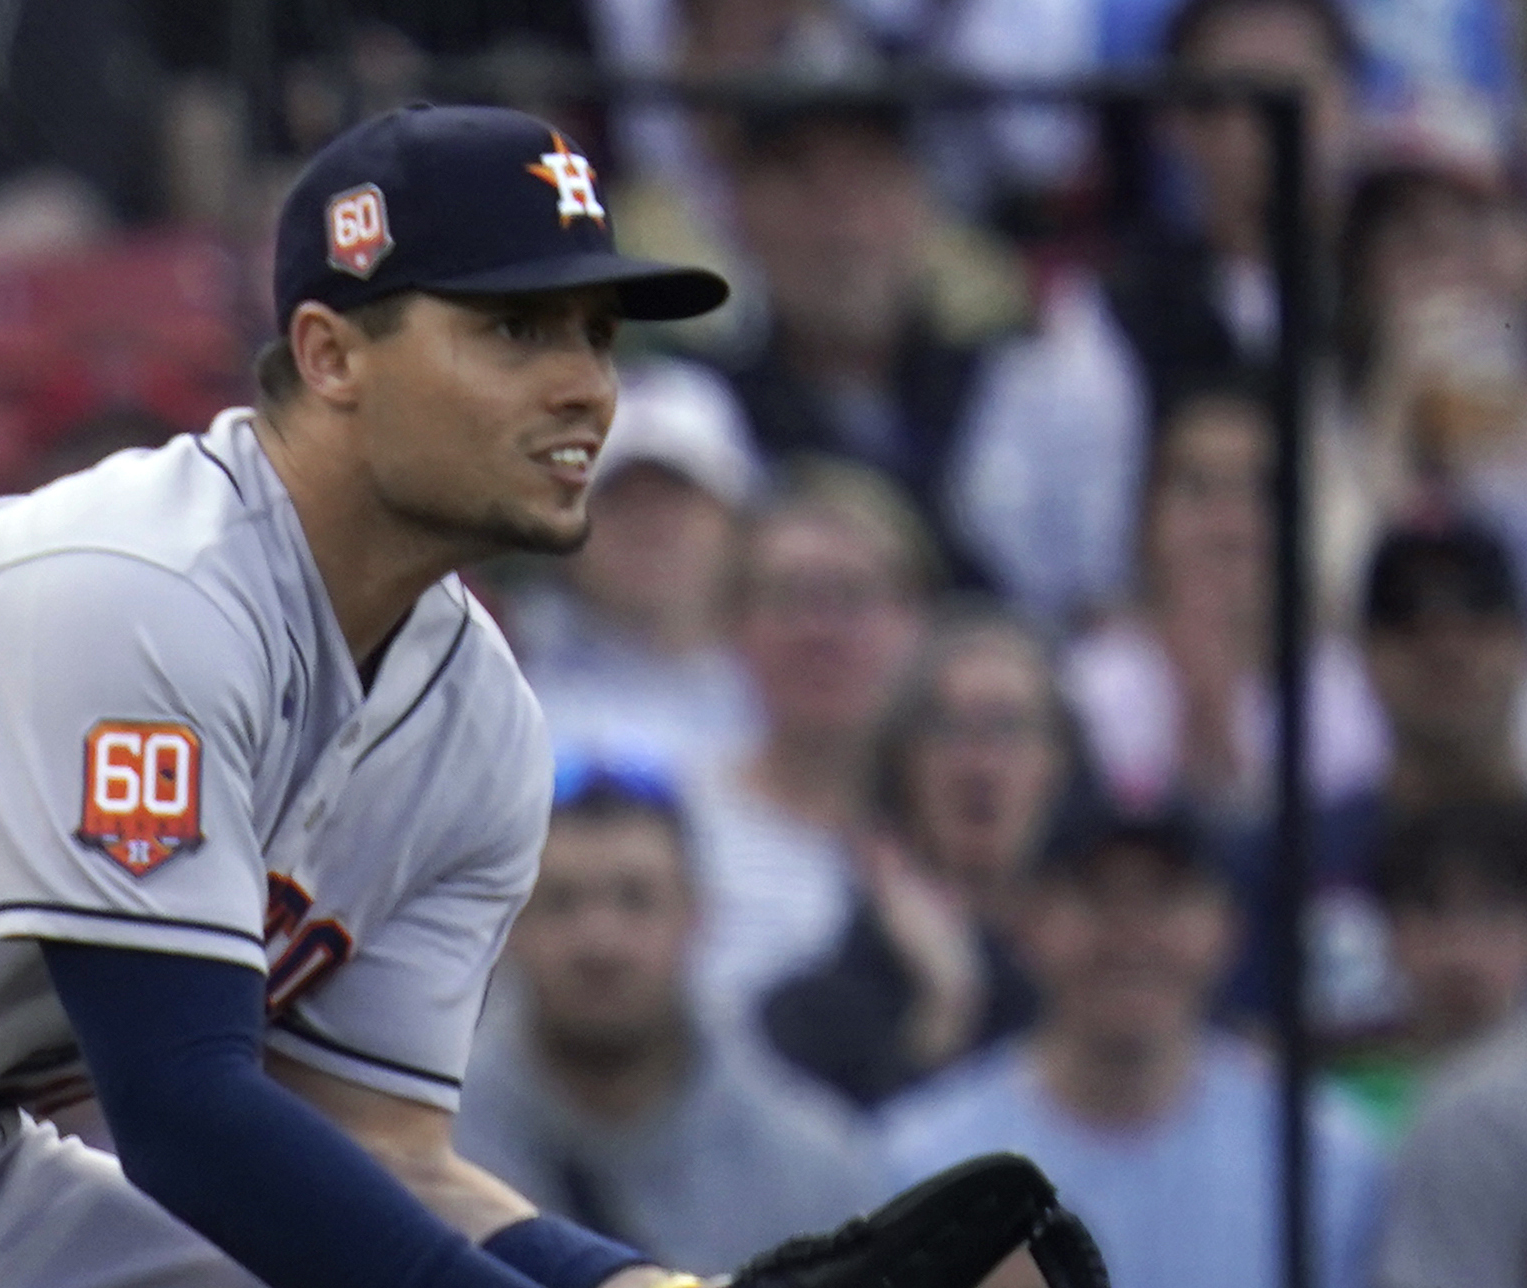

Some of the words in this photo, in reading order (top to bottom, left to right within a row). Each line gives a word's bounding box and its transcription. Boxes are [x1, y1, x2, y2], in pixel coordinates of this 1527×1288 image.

[541, 153, 606, 217] H
[334, 193, 380, 247] 60
[94, 732, 191, 815] 60
